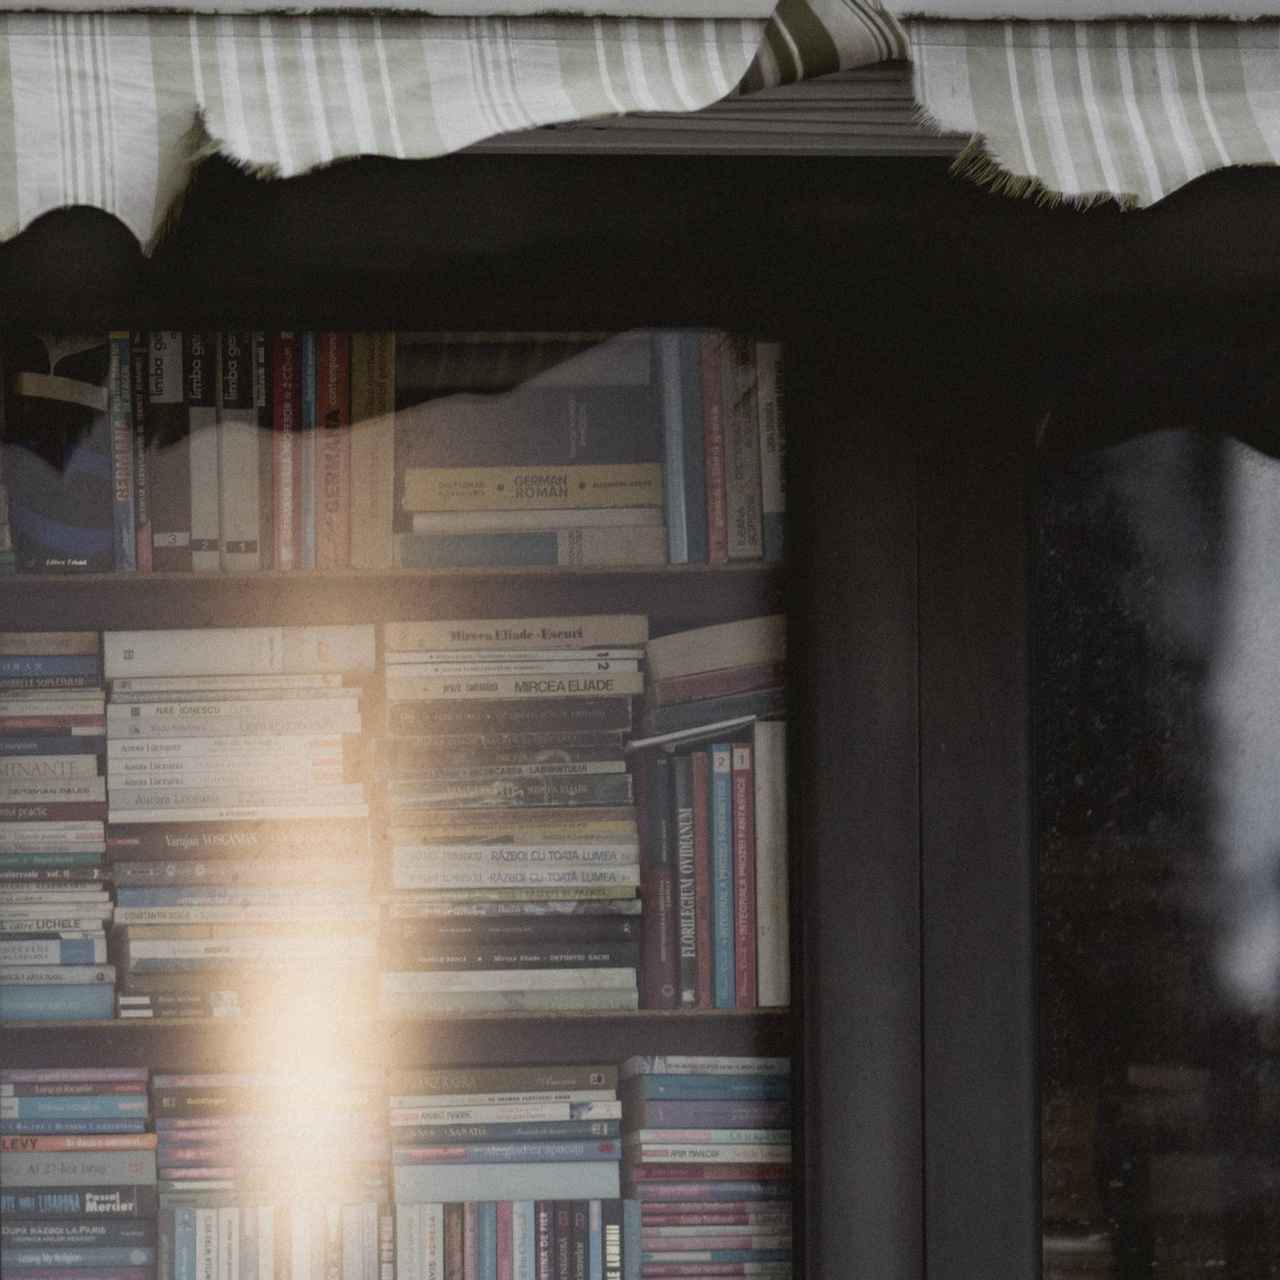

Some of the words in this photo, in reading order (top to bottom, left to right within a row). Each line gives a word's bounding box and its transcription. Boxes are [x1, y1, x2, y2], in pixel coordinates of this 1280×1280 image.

[451, 631, 492, 641] Mircea
[495, 630, 534, 640] Eliade
[542, 628, 584, 639] Eseuri
[515, 680, 565, 692] MIRCEA
[568, 679, 614, 691] ELIADE
[680, 808, 693, 873] OVIDIANUM
[491, 849, 528, 861] RĂZBOI
[531, 851, 546, 861] CU
[549, 850, 579, 860] TOATĂ
[582, 850, 617, 860] LUMEA
[529, 872, 544, 882] CU
[581, 872, 617, 882] LUMEA
[681, 879, 695, 957] FLORILEGIUM
[540, 1212, 548, 1231] FIER
[541, 1234, 549, 1247] DE
